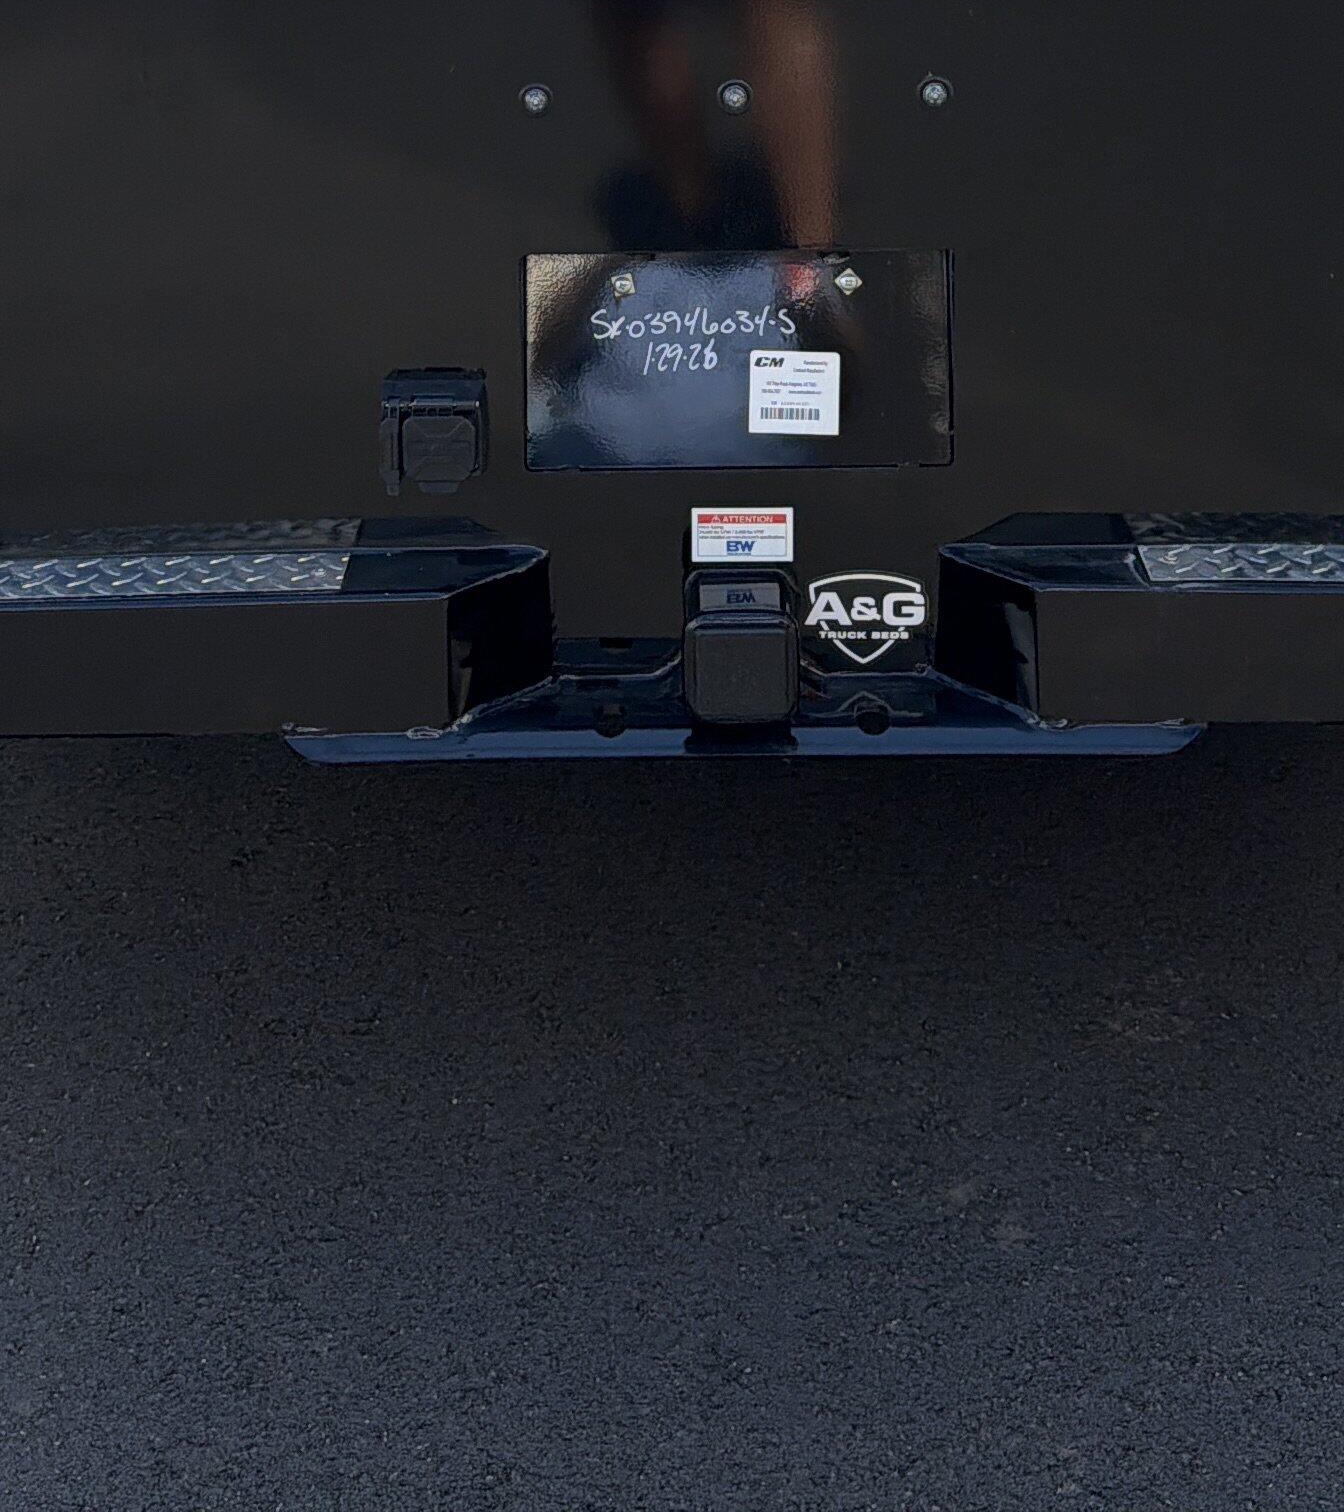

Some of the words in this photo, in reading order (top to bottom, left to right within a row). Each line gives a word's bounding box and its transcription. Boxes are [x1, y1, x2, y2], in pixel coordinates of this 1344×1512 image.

[754, 356, 785, 368] CM
[722, 515, 773, 523] ATTENTION
[804, 591, 926, 626] A&G
[819, 630, 868, 640] TRUCK
[871, 630, 910, 640] BEDS
